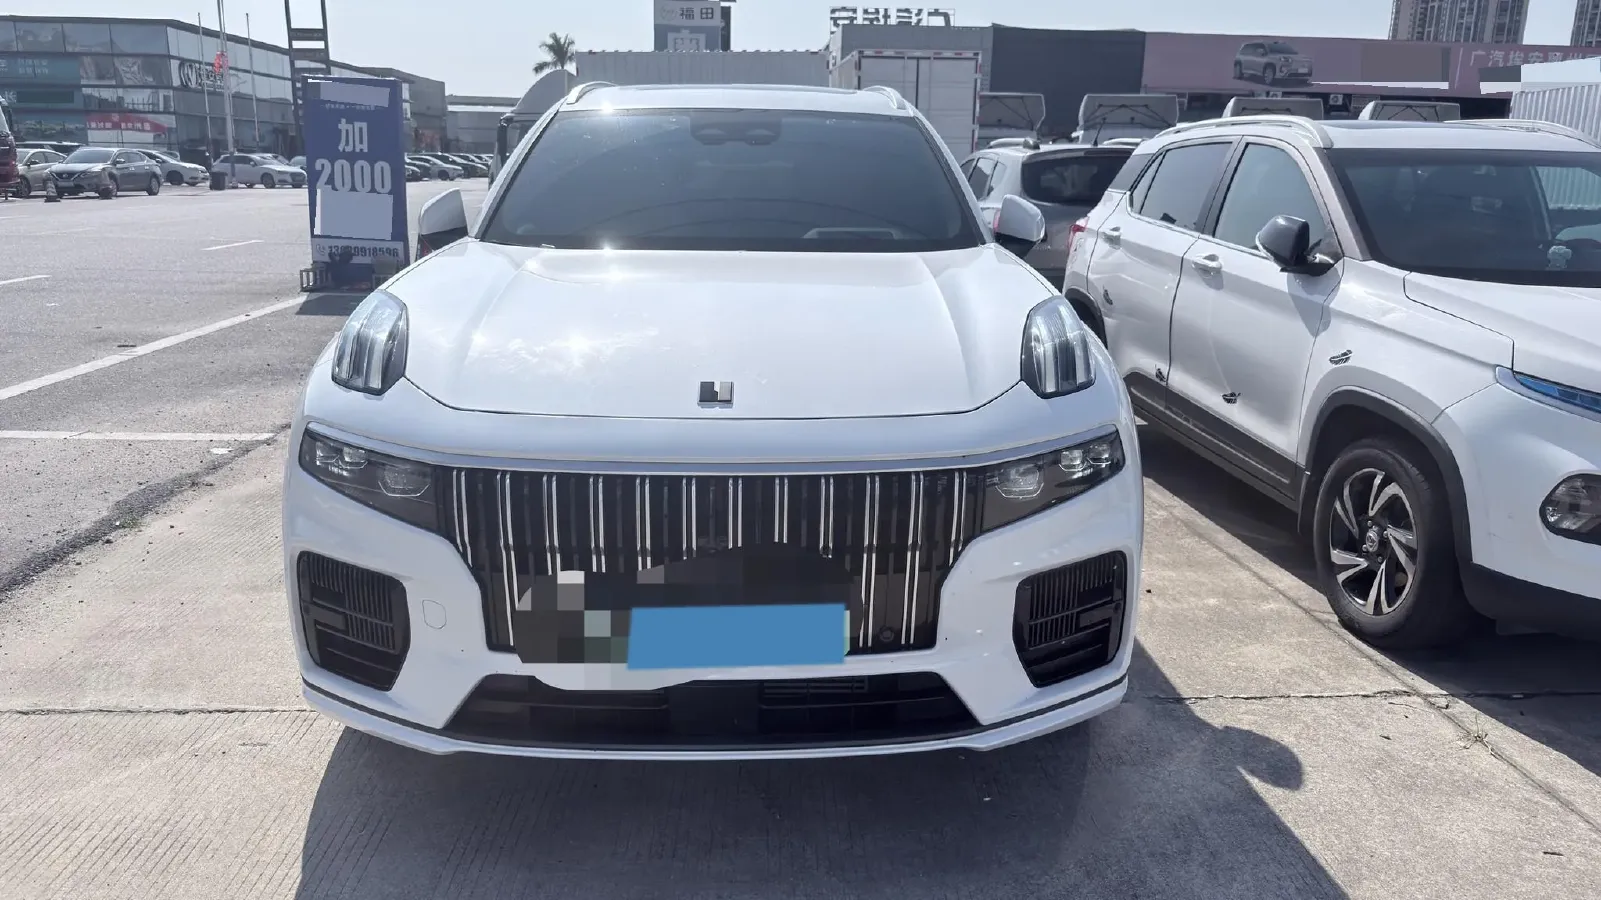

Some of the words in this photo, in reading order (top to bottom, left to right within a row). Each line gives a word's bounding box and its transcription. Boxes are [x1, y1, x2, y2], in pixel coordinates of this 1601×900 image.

[679, 7, 714, 20] 福田
[338, 118, 368, 152] 加
[315, 158, 392, 194] 2000
